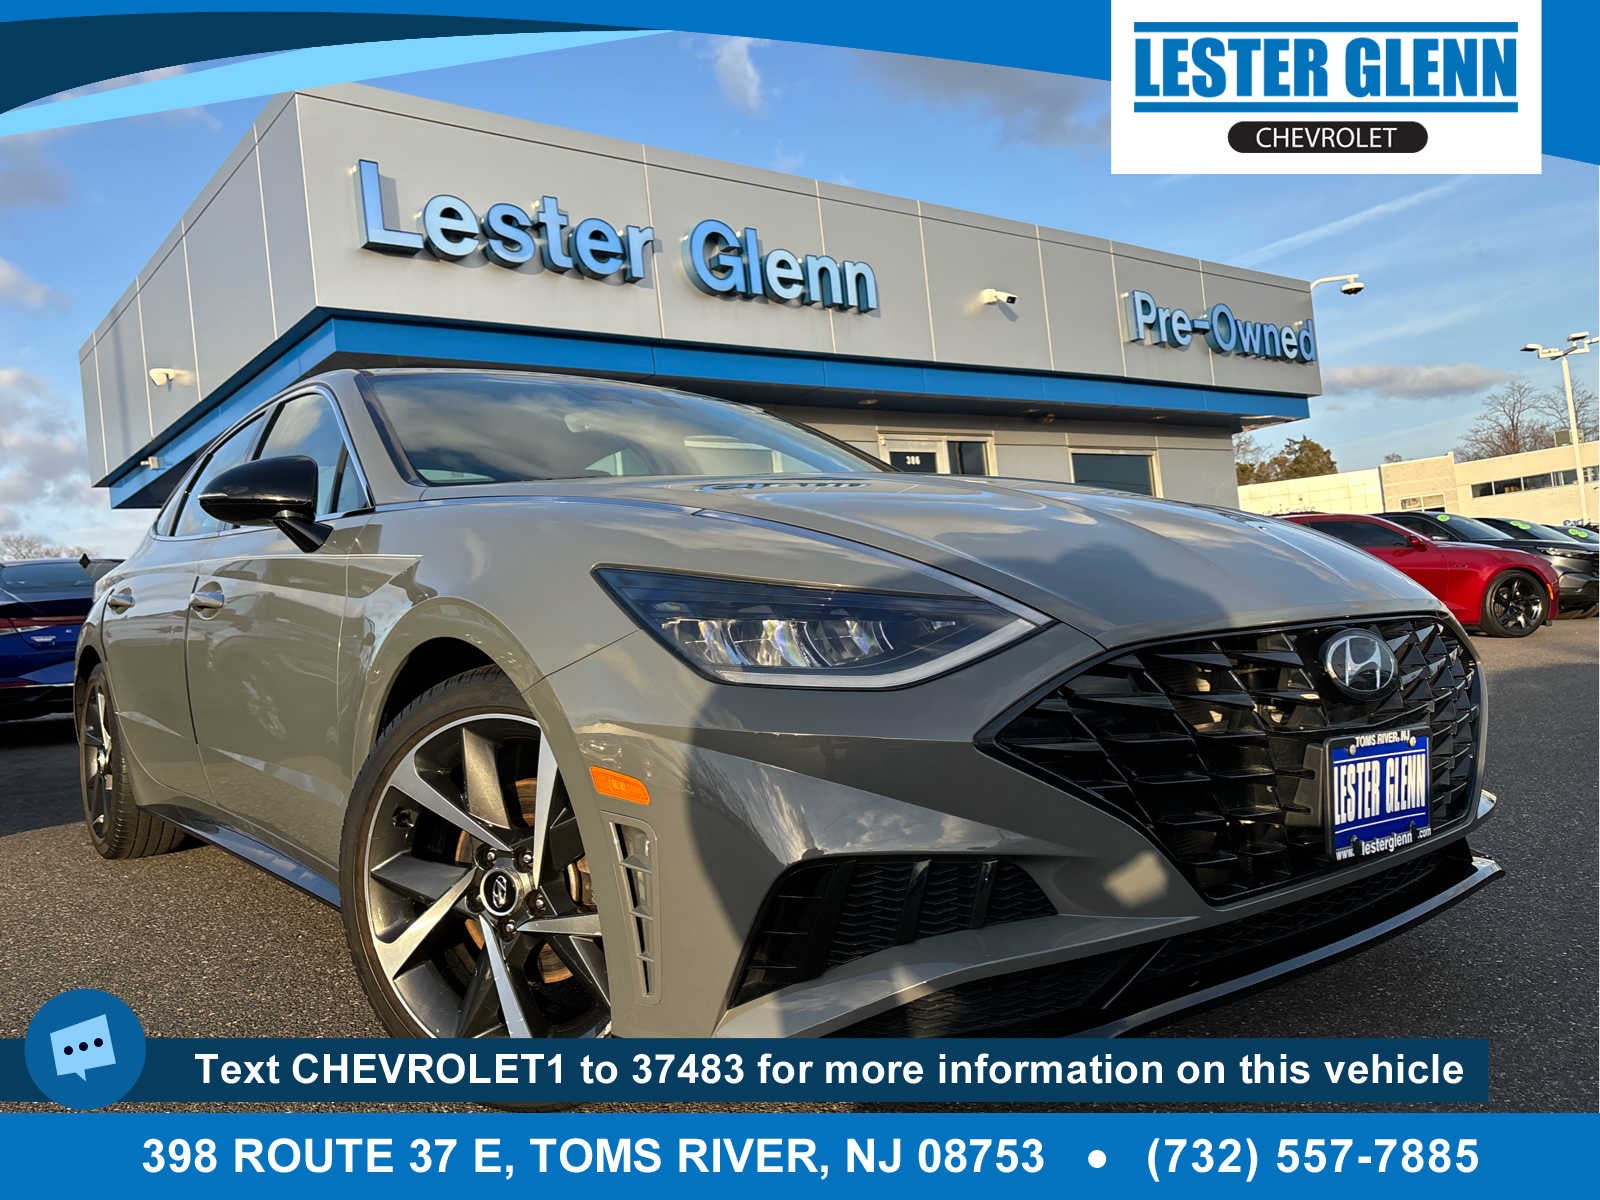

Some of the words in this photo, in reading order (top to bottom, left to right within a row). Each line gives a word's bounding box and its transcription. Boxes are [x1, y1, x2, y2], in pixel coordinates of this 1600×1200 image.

[353, 159, 654, 283] Lester
[684, 218, 878, 313] Glenn
[1129, 290, 1316, 362] Pre-Owned
[1355, 735, 1376, 748] TOMS
[1401, 730, 1411, 742] NJ
[1333, 760, 1381, 826] LESTER
[1385, 753, 1426, 814] GLENN
